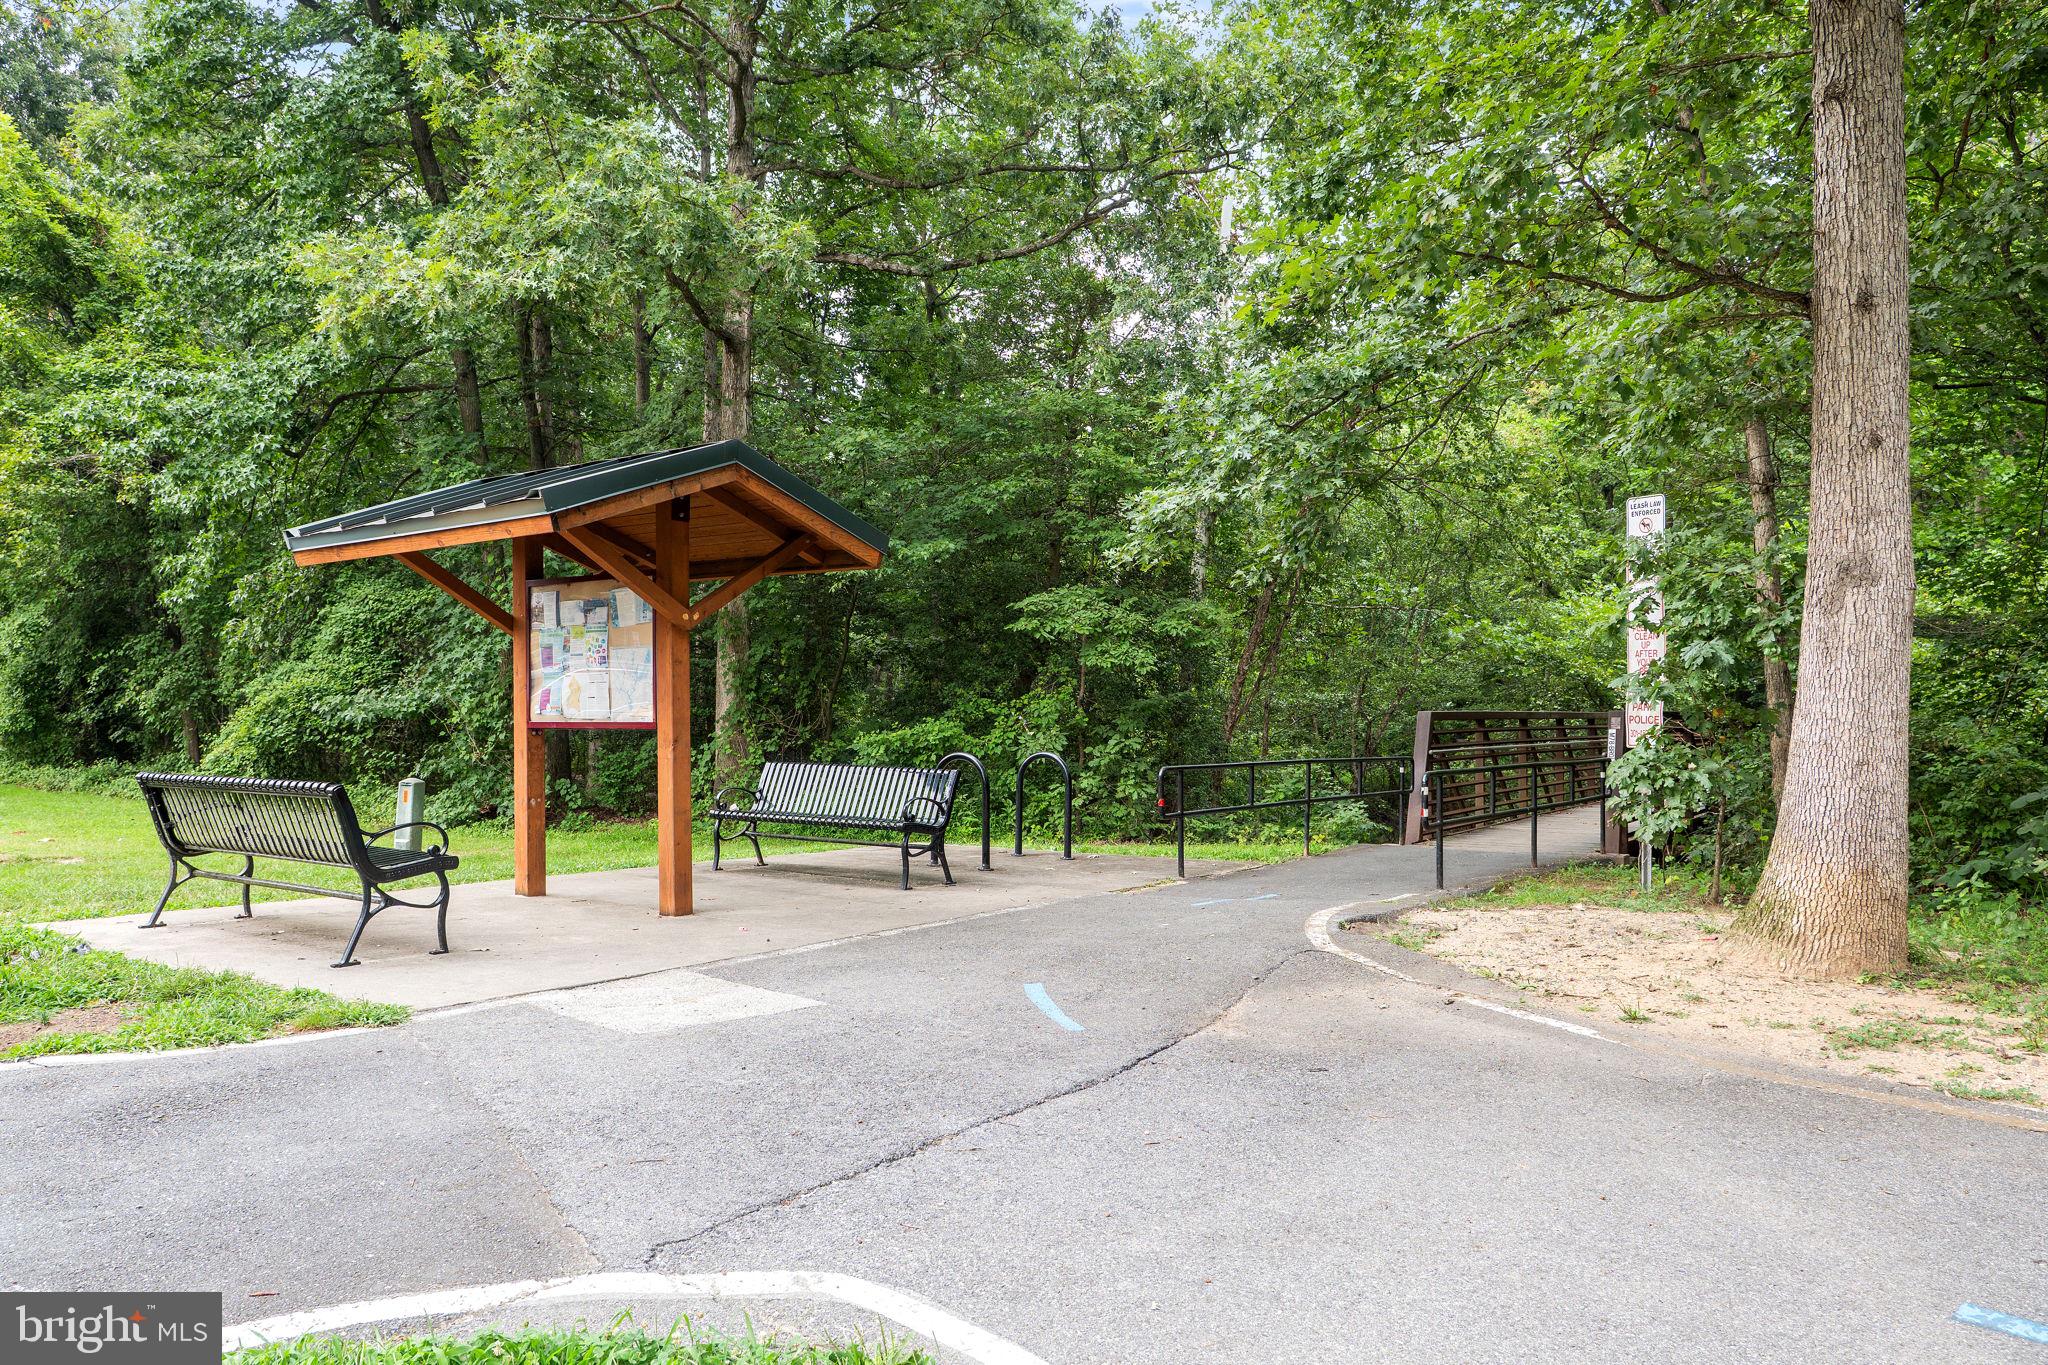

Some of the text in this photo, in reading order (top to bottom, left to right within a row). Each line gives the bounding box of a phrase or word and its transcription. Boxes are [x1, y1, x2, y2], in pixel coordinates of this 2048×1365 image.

[1630, 501, 1649, 510] LEASH
[1631, 508, 1660, 517] ENFORCED
[1634, 632, 1658, 640] CLEAN
[1640, 641, 1650, 649] UP
[1635, 650, 1658, 658] AFTER
[1628, 716, 1660, 724] POLICE
